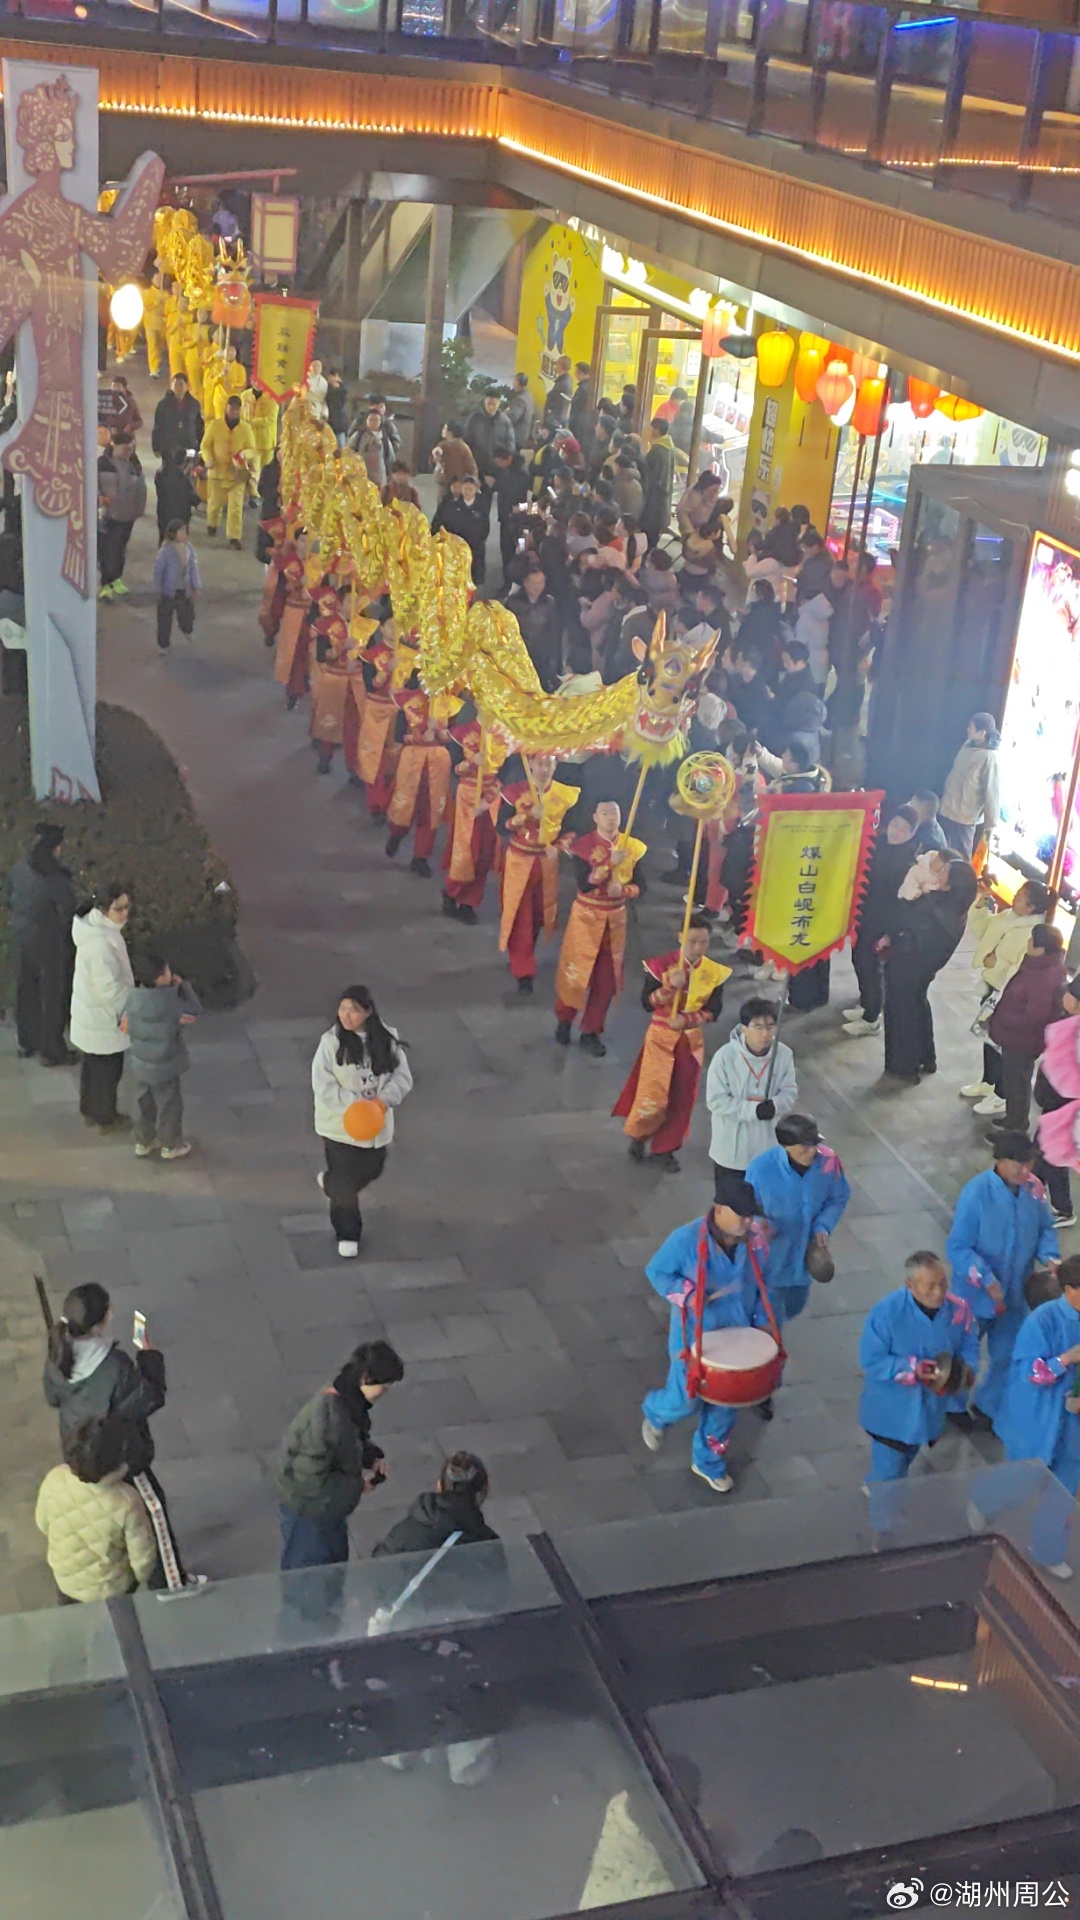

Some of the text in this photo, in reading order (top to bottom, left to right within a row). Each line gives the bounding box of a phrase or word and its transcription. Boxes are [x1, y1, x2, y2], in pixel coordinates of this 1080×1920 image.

[789, 845, 822, 947] 煤山白岘布龙
